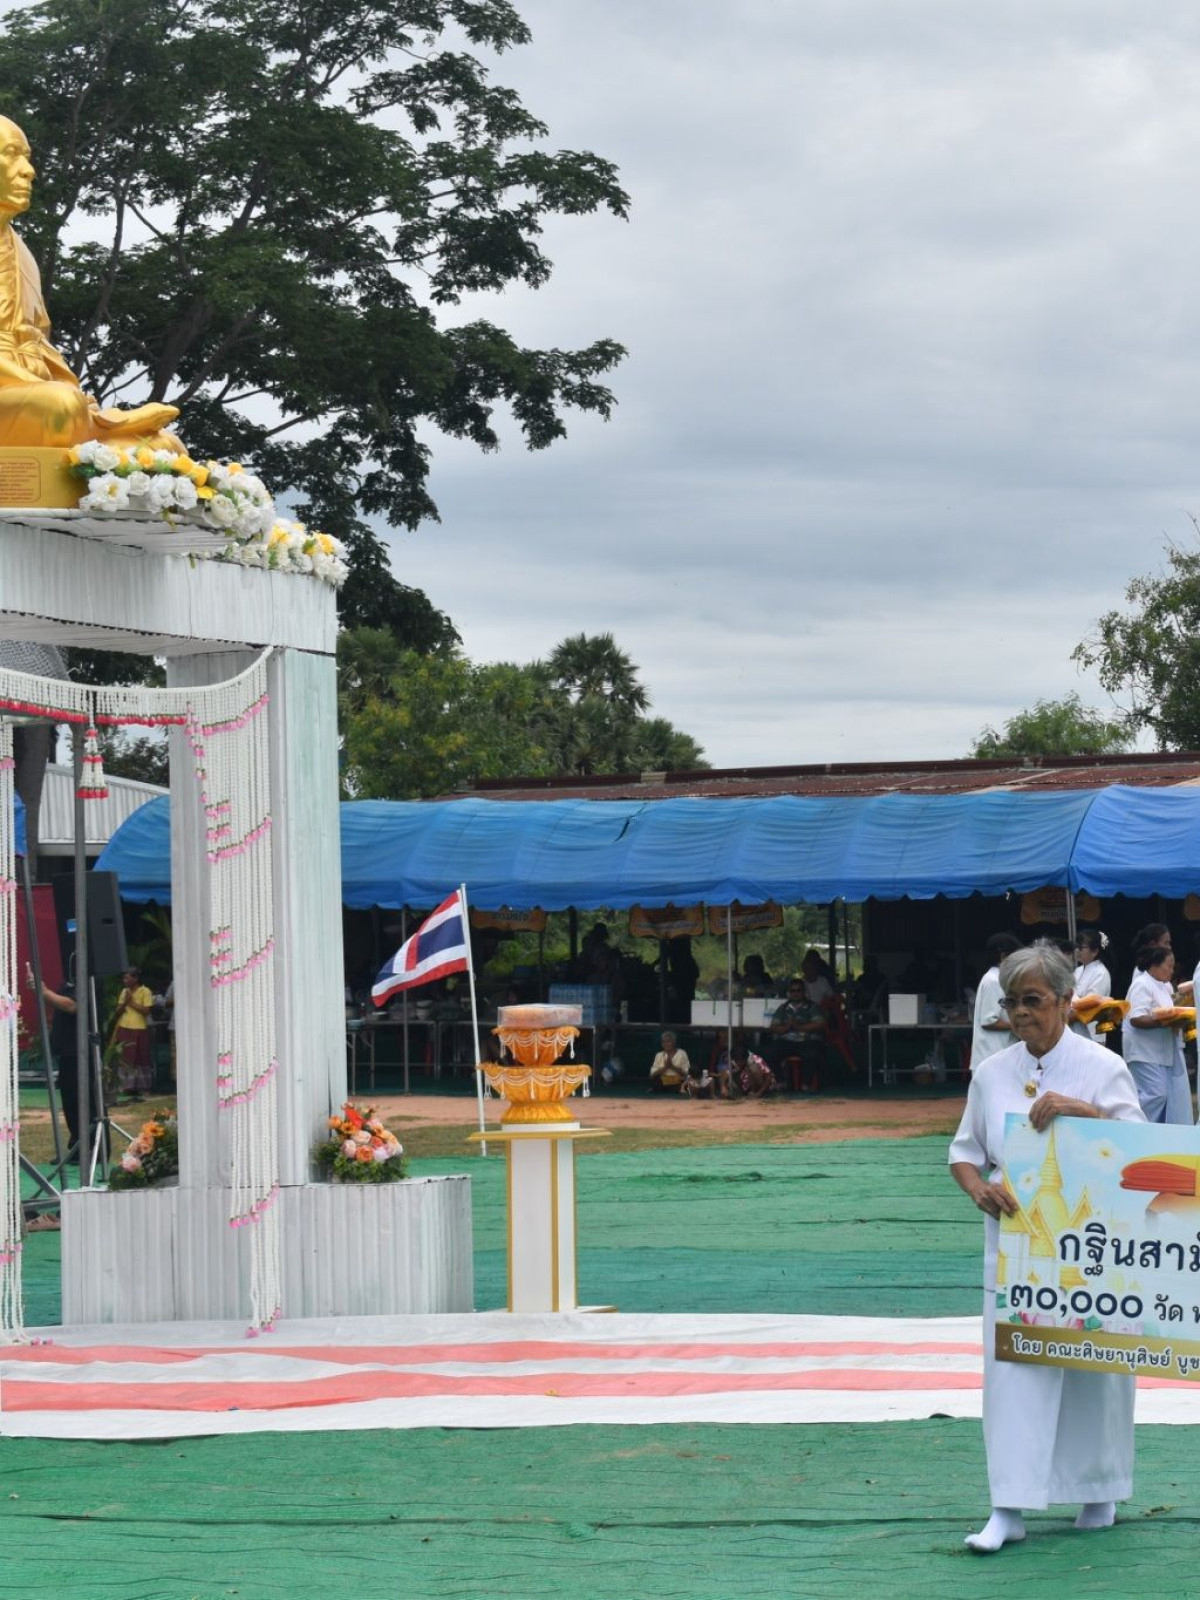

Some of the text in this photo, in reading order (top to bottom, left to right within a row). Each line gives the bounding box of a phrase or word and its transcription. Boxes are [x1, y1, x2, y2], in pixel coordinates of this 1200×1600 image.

[1010, 1284, 1143, 1319] ๓๐,๐๐๐
[1154, 1294, 1184, 1322] วัด
[1013, 1334, 1042, 1354] โดย
[1047, 1341, 1171, 1369] คณะศิษยานุศิษย์
